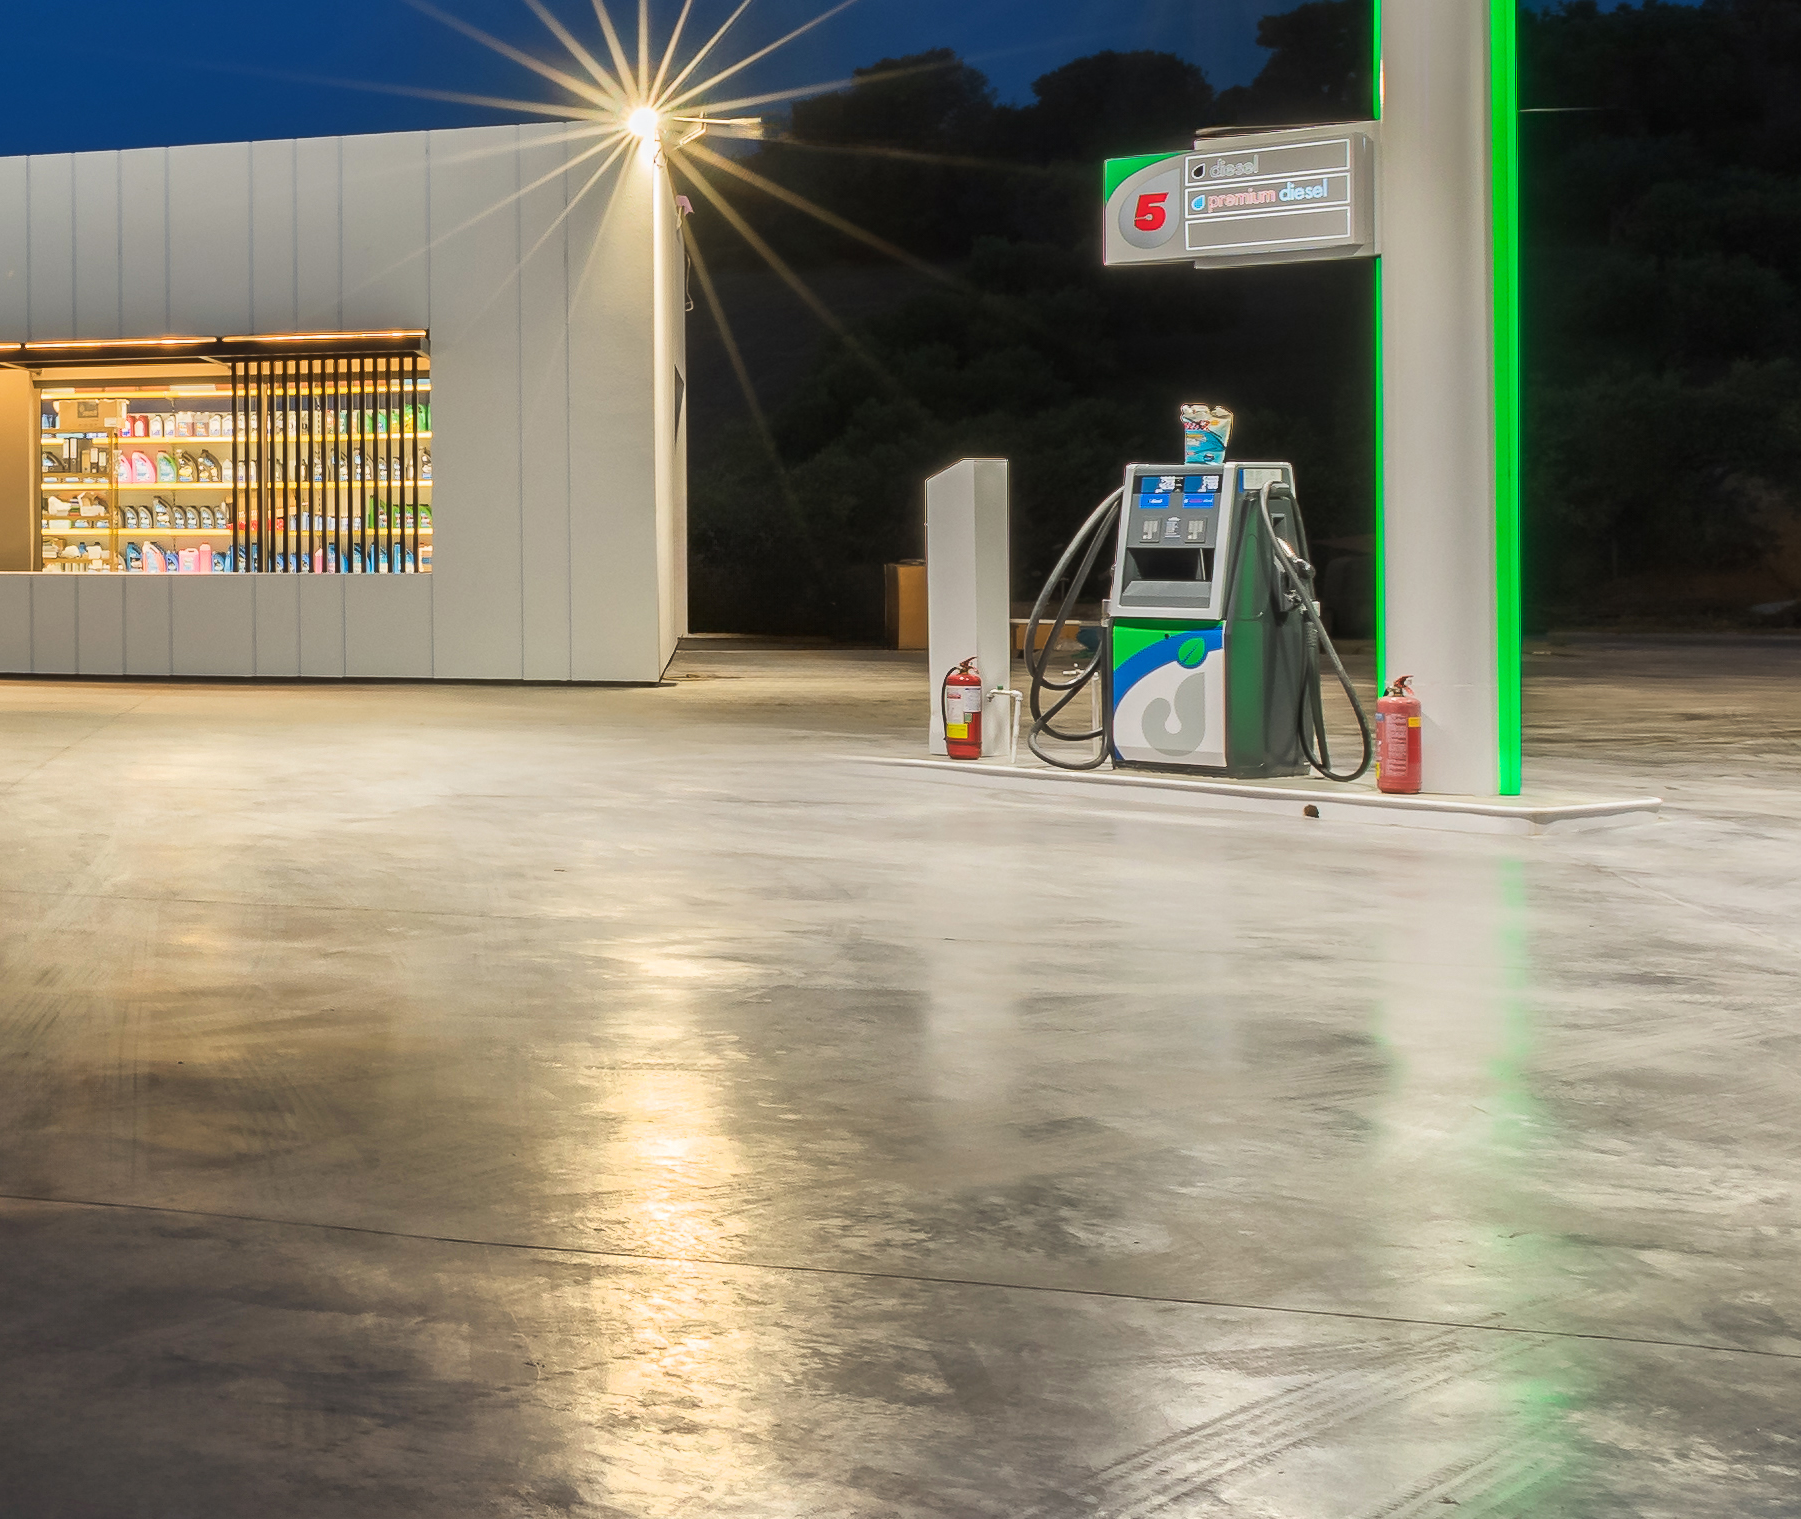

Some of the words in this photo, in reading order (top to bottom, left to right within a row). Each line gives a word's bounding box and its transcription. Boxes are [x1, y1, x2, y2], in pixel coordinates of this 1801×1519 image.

[1209, 154, 1259, 179] diesel
[1134, 191, 1169, 232] 5
[1207, 188, 1276, 213] premium
[1279, 178, 1328, 202] diesel
